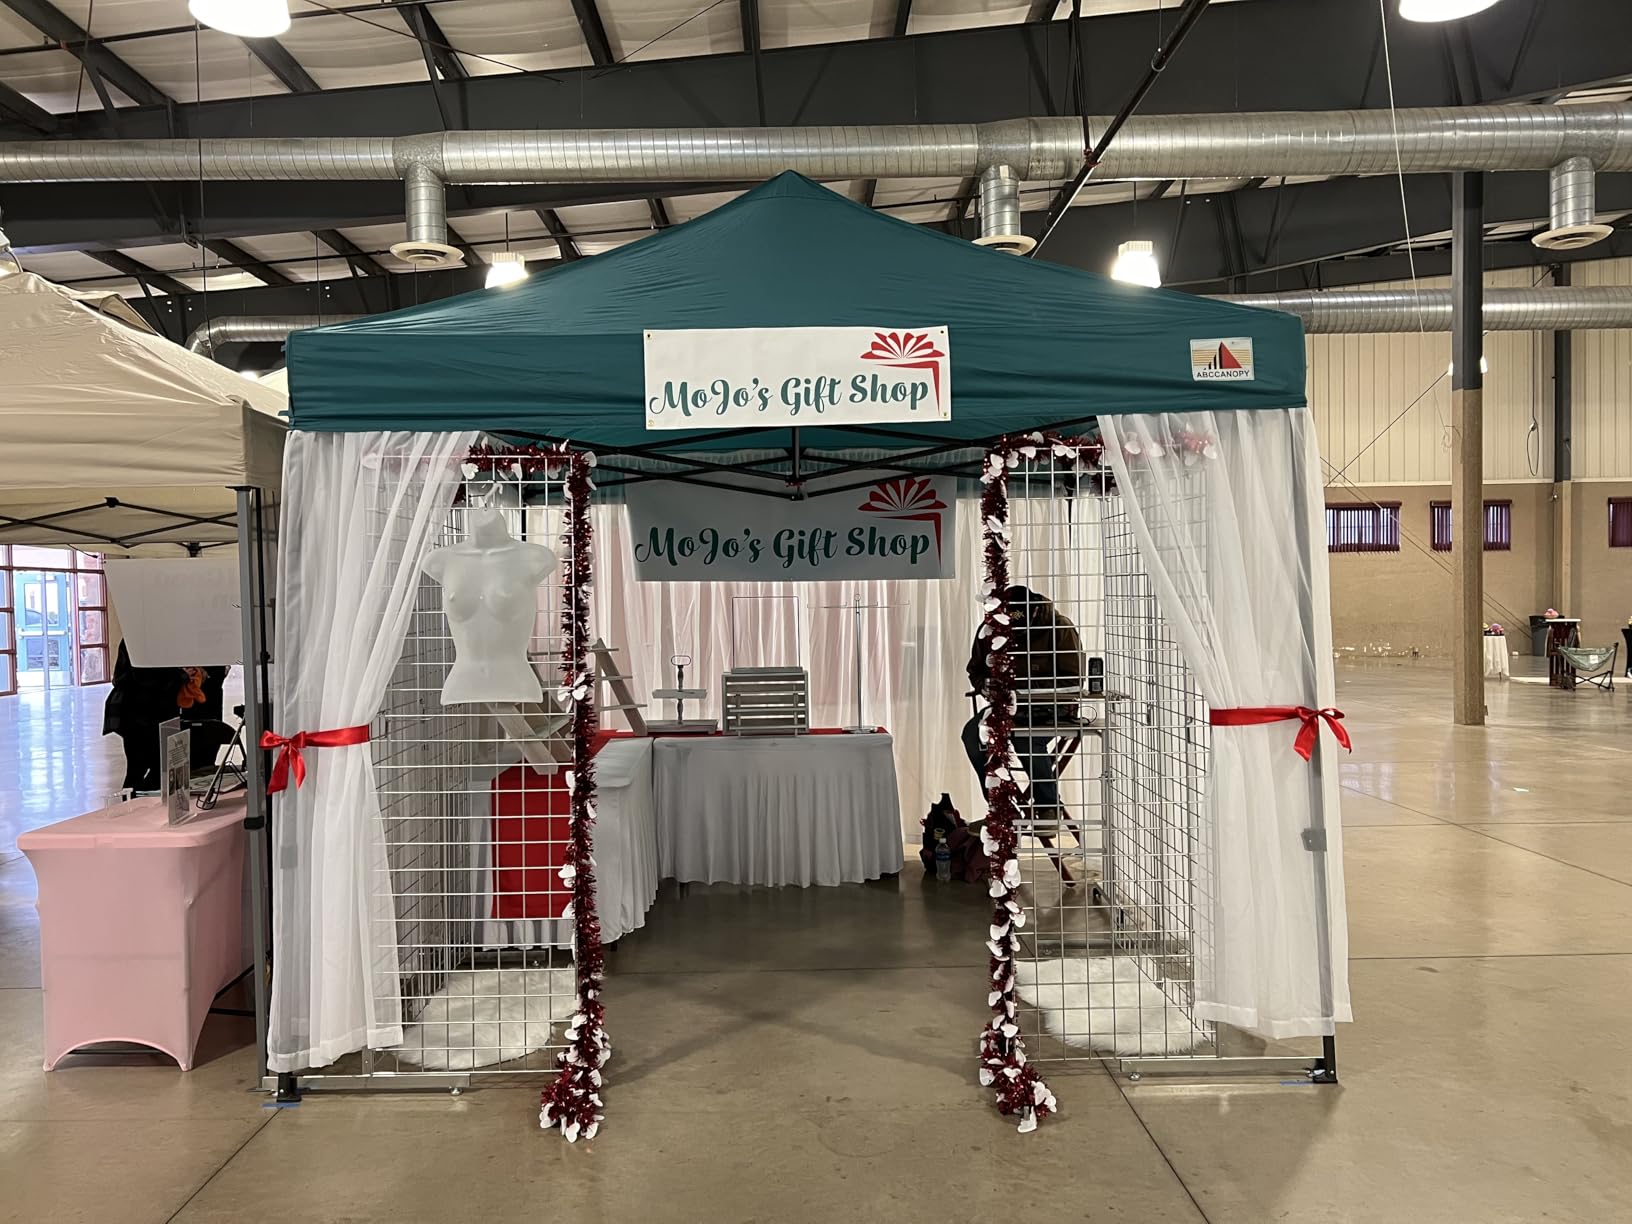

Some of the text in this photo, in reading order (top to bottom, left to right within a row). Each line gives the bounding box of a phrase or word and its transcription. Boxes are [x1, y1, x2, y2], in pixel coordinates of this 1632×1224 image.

[649, 373, 929, 416] MoJo's Gift Shop
[1196, 370, 1250, 378] ABCCANOPY
[634, 526, 930, 569] MoJo's Gift Shop
